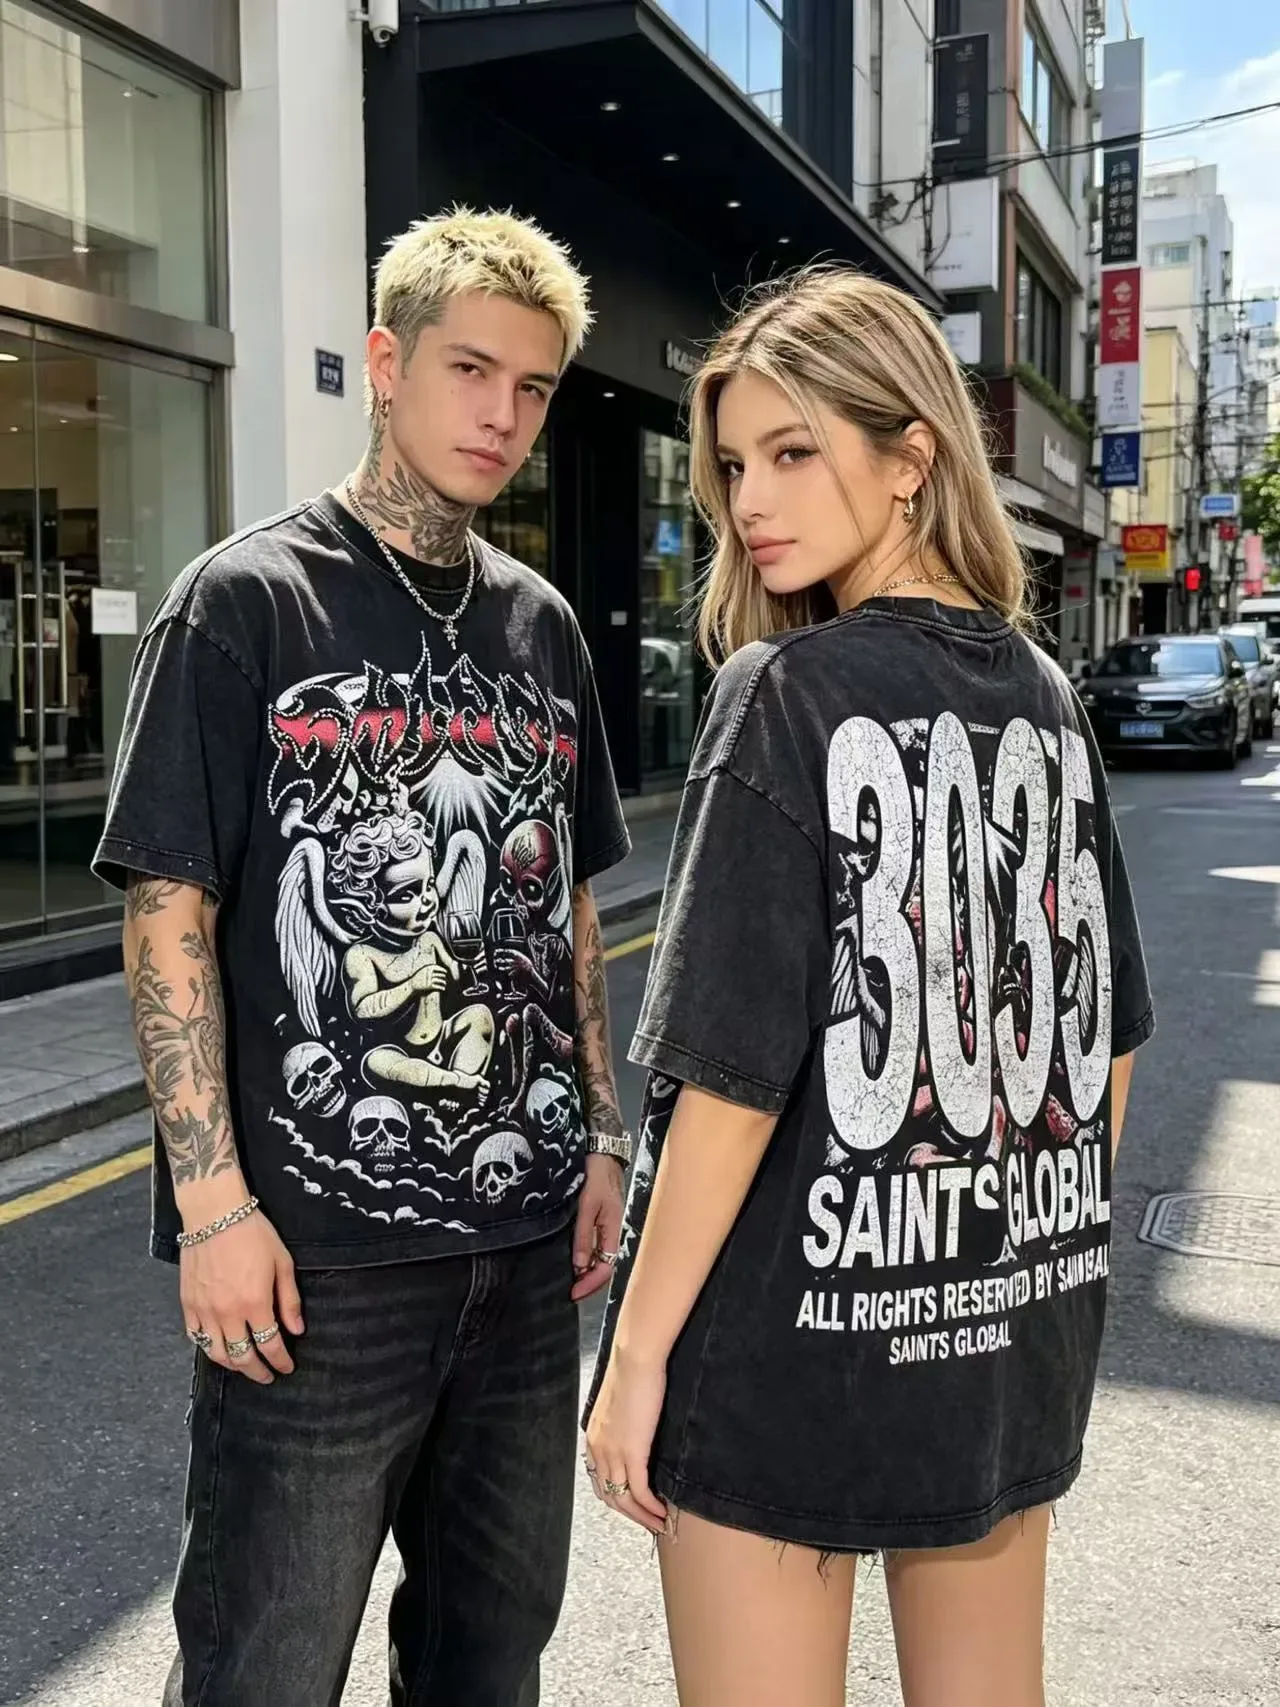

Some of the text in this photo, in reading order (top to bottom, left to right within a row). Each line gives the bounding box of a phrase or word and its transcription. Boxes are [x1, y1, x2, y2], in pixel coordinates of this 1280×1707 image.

[824, 711, 1112, 1150] 3035
[1006, 1144, 1111, 1246] GLOBAL
[796, 1290, 845, 1331] ALL
[851, 1286, 937, 1331] RIGHTS
[943, 1269, 1031, 1320] RESERVED
[1035, 1261, 1053, 1300] BY
[889, 1320, 1012, 1365] SAINTS GLOBAL
